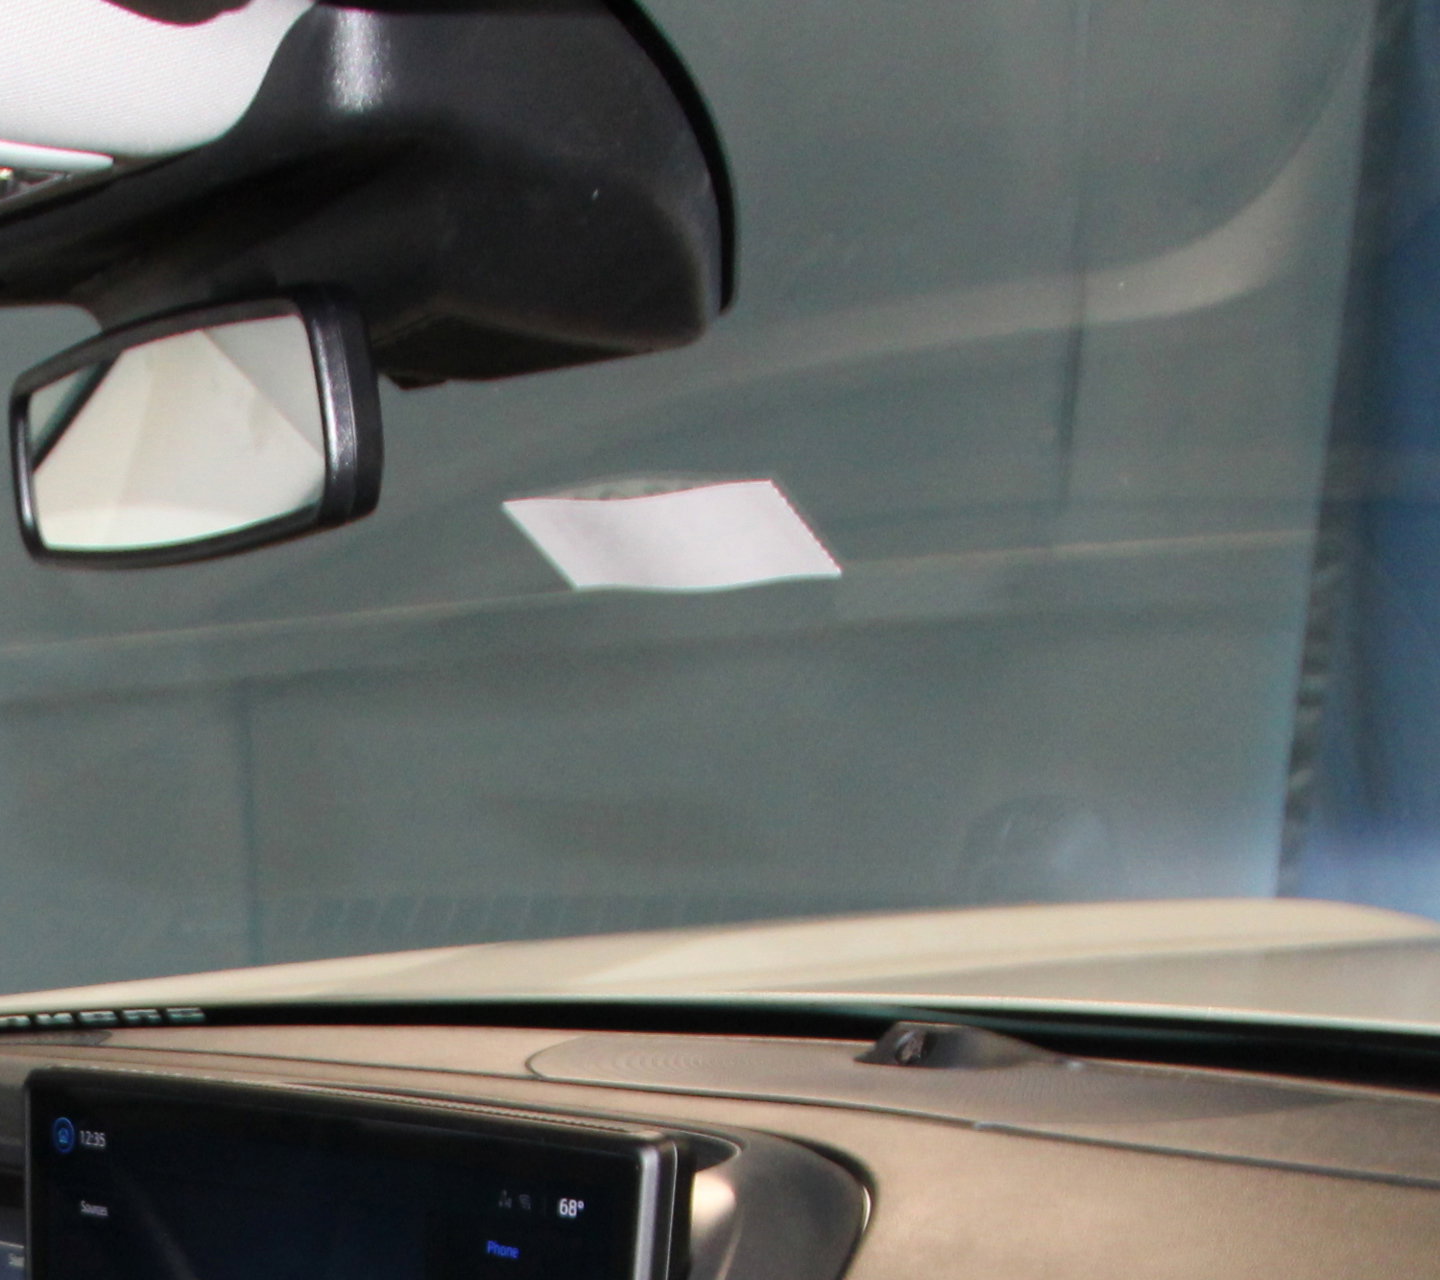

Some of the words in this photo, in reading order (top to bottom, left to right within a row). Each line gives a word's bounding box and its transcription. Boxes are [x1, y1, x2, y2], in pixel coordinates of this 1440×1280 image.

[79, 1130, 106, 1147] 12:35
[559, 1198, 584, 1216] 68°
[487, 1240, 519, 1258] Phone
